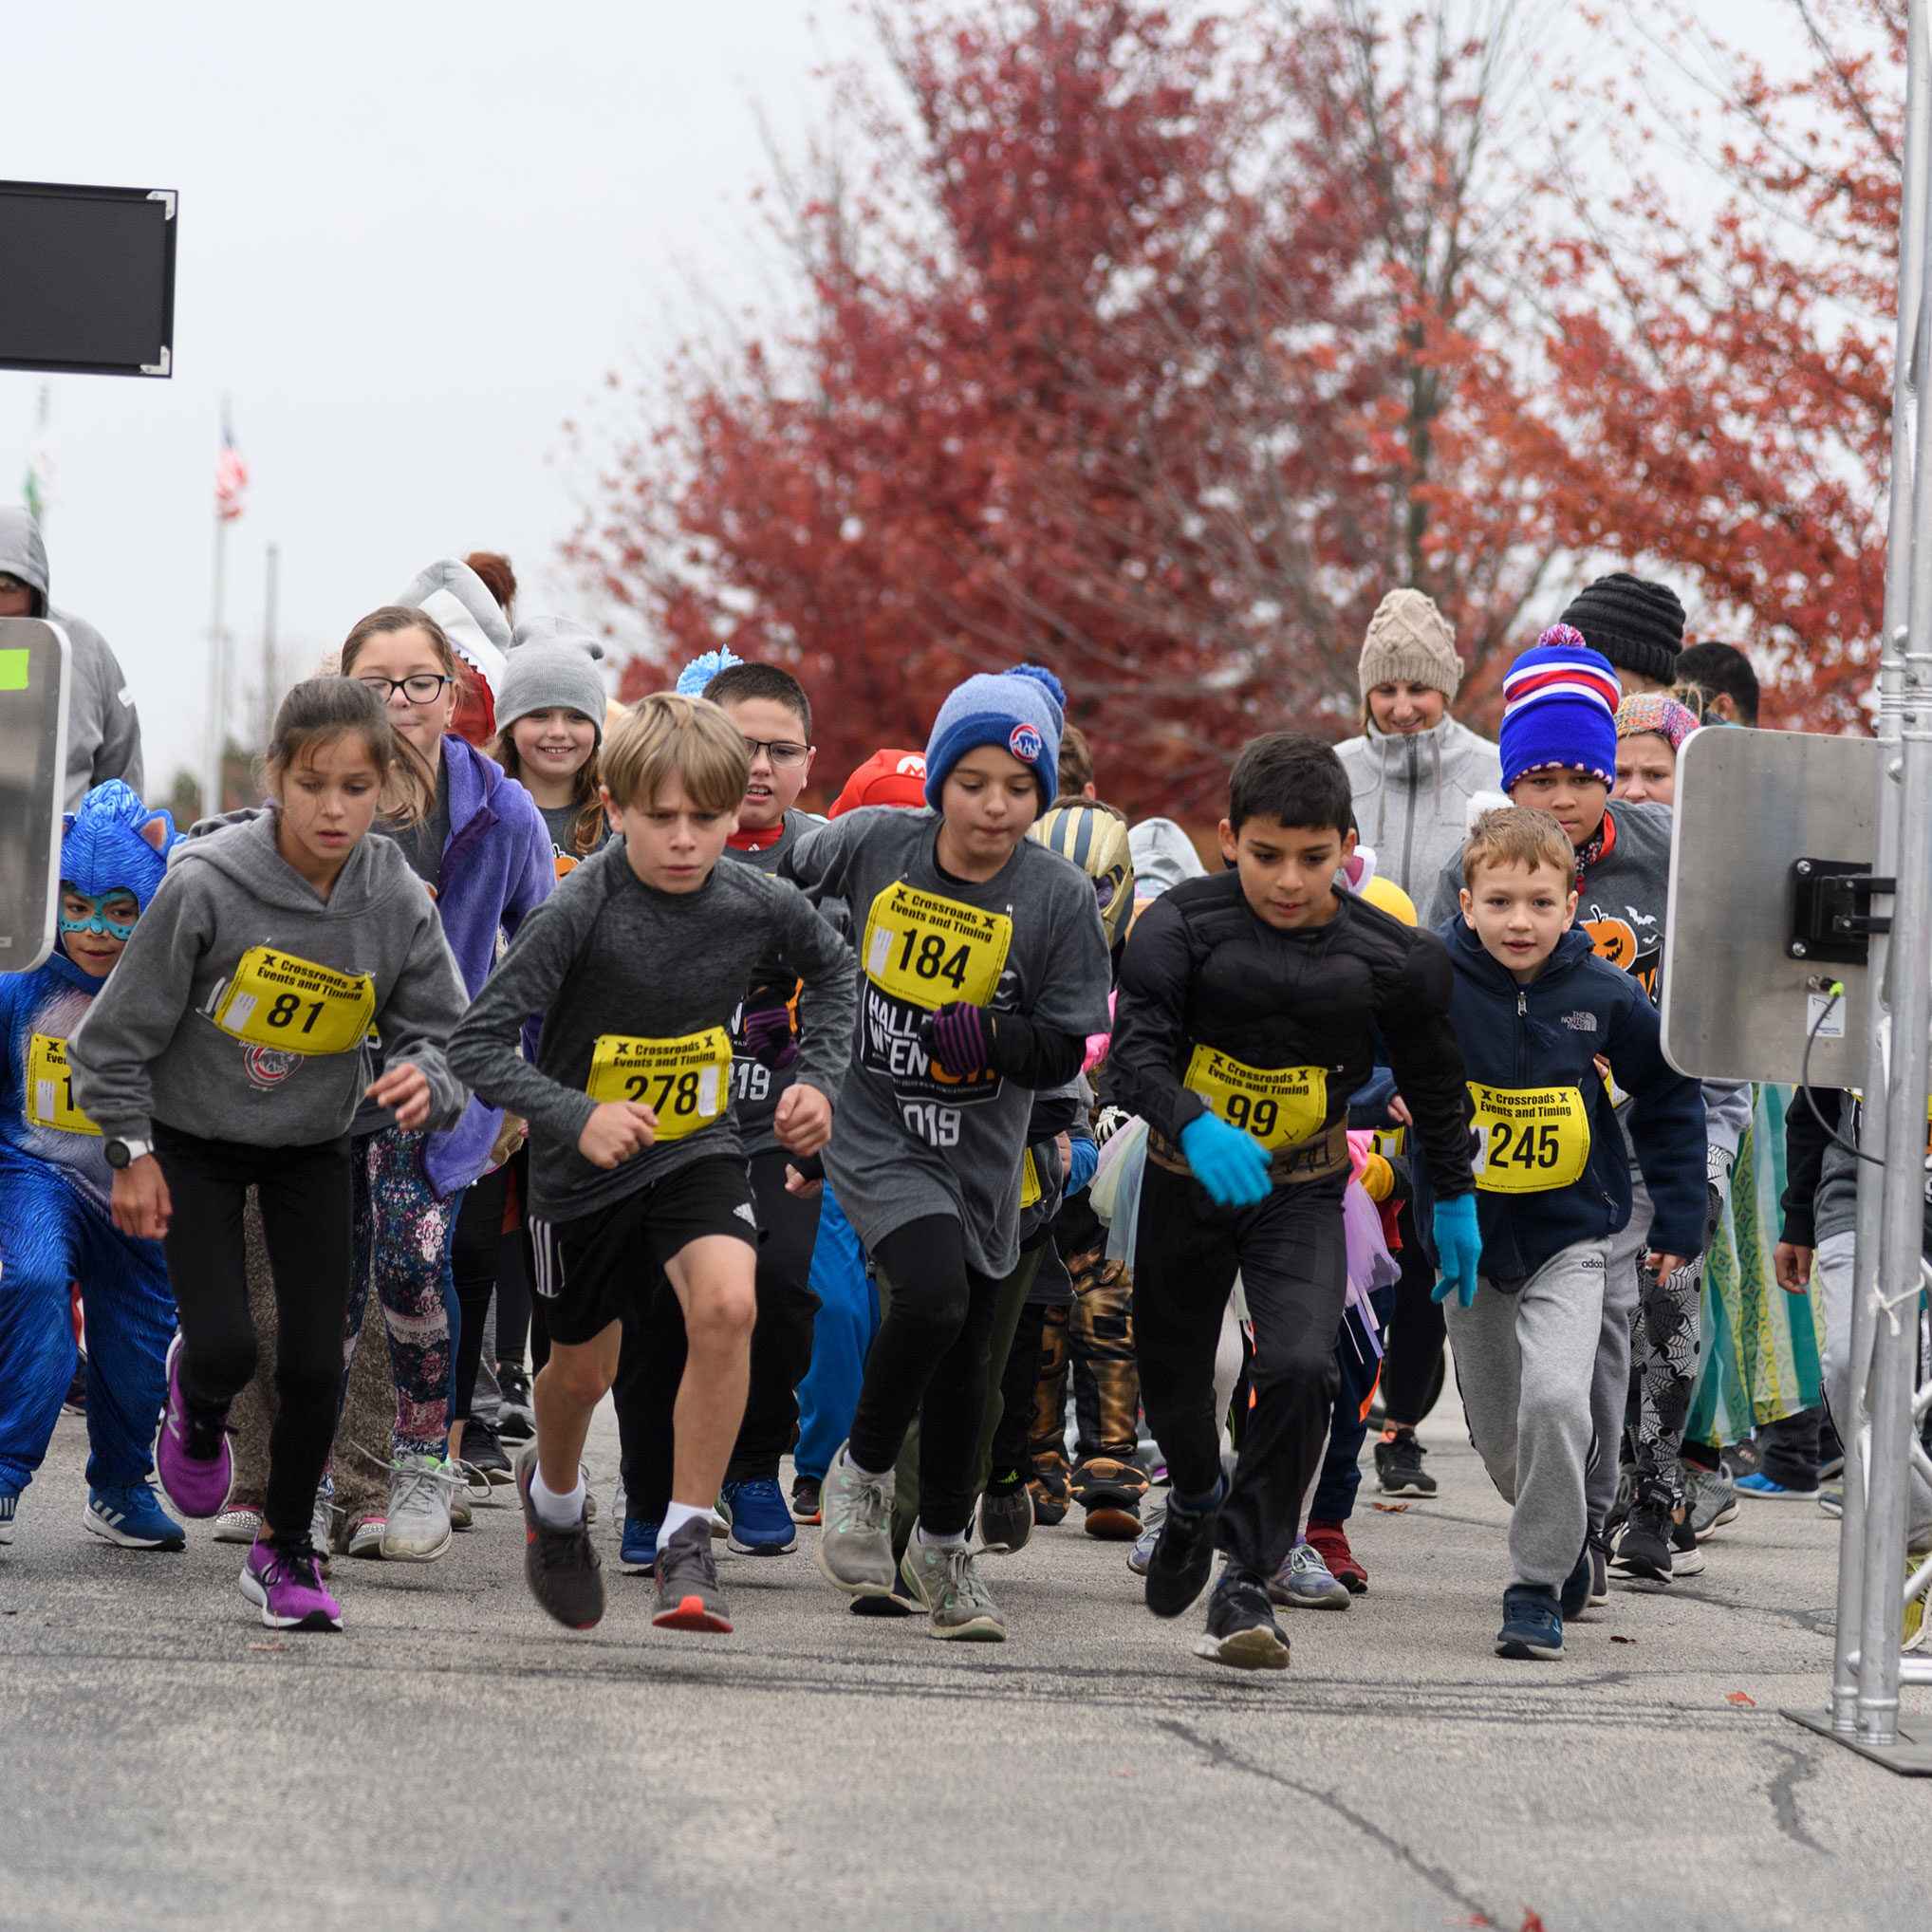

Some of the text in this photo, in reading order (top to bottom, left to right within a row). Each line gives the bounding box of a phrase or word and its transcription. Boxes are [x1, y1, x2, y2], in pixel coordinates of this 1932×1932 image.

[890, 901, 993, 943] Events and Timing
[912, 895, 977, 924] Crossroads
[281, 960, 348, 989] Crossroads
[900, 928, 971, 990] 184
[257, 966, 362, 1001] Events and Timing
[267, 994, 325, 1033] 81
[613, 1051, 715, 1068] Events and Timing
[635, 1041, 700, 1055] Crossroads
[1208, 1065, 1310, 1096] Events and Timing
[1228, 1062, 1293, 1084] Crossroads
[624, 1071, 699, 1116] 278
[1480, 1101, 1571, 1118] Events and Timing
[1495, 1093, 1555, 1105] Crossroads
[897, 1103, 962, 1146] 019
[1224, 1094, 1278, 1137] 99
[1489, 1122, 1559, 1169] 245
